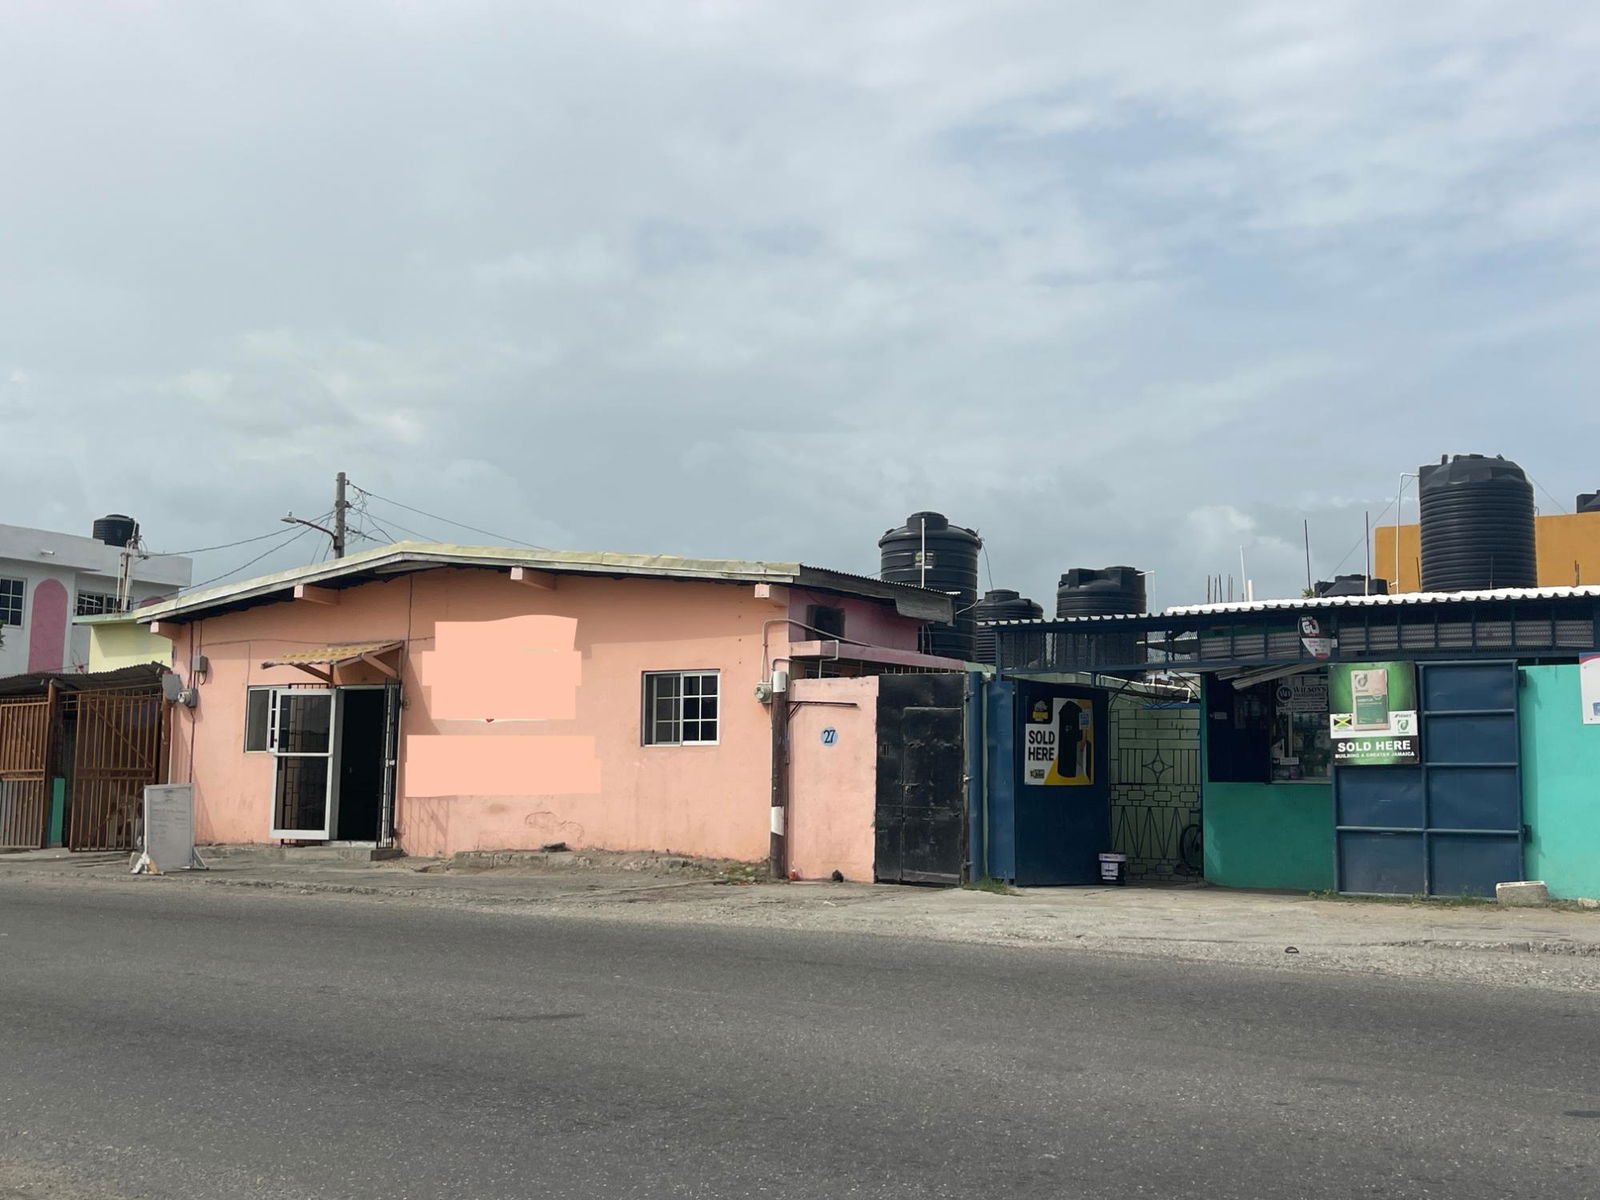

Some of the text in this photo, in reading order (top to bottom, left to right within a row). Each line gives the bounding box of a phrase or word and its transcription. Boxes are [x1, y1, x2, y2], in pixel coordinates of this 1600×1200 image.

[823, 729, 836, 744] 27
[1028, 730, 1055, 745] SOLD
[1337, 740, 1410, 752] SOLD HERE
[1028, 747, 1055, 761] HERE
